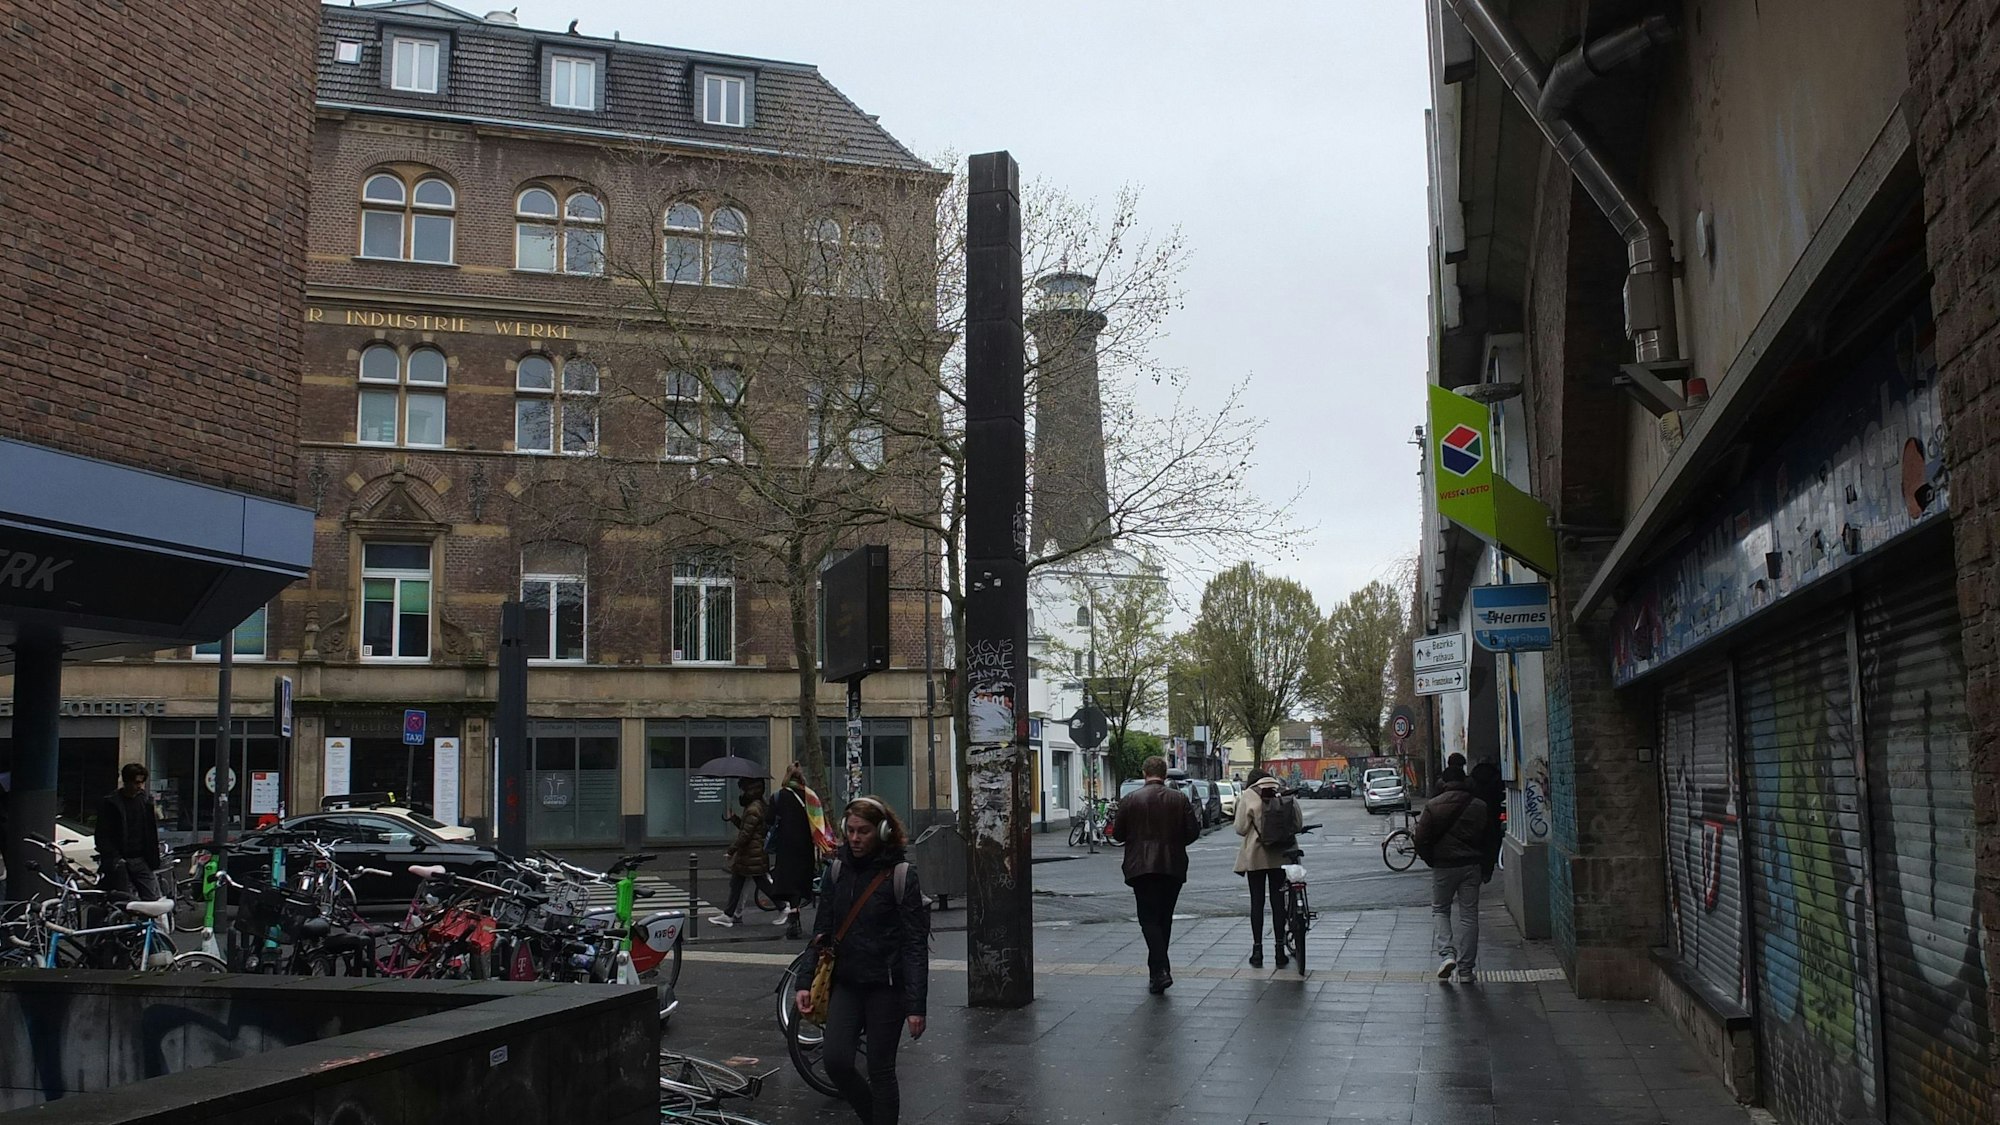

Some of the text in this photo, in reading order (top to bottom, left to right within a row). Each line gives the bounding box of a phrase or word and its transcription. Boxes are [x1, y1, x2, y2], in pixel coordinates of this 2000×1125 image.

[347, 310, 471, 333] INDUSTRIE
[495, 320, 576, 340] WERKE
[0, 549, 73, 592] RK
[1494, 612, 1546, 624] Hermes
[1432, 639, 1456, 650] Bezirks-
[1433, 652, 1454, 662] rathaus
[1396, 722, 1405, 731] 30
[405, 733, 423, 743] TAXI
[654, 929, 667, 938] KVB
